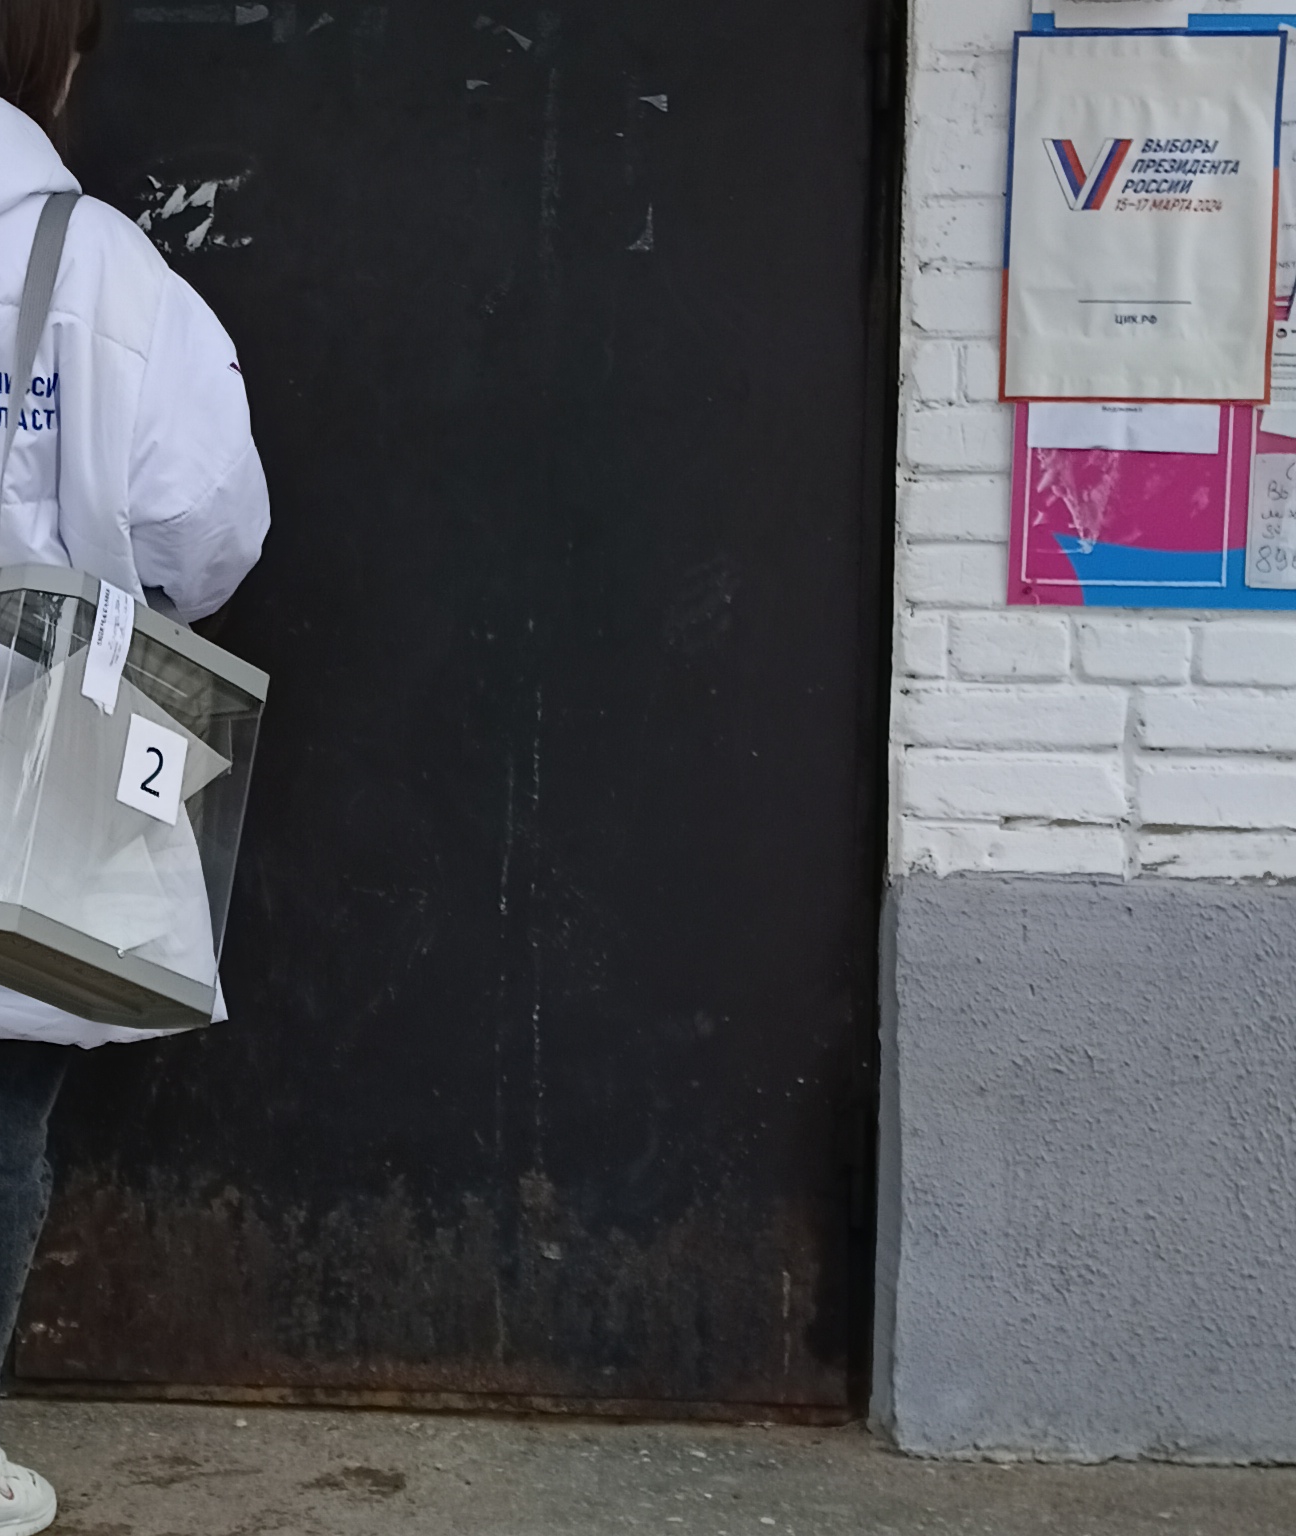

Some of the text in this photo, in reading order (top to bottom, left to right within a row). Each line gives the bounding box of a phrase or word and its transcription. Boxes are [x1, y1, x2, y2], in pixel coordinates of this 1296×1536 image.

[1140, 138, 1220, 154] ВЫБОРЫ
[1130, 158, 1241, 176] ПРЕЗИДЕНТА
[1121, 178, 1194, 194] РОССИИ
[1149, 198, 1193, 212] МАРТА
[140, 745, 165, 799] 2
